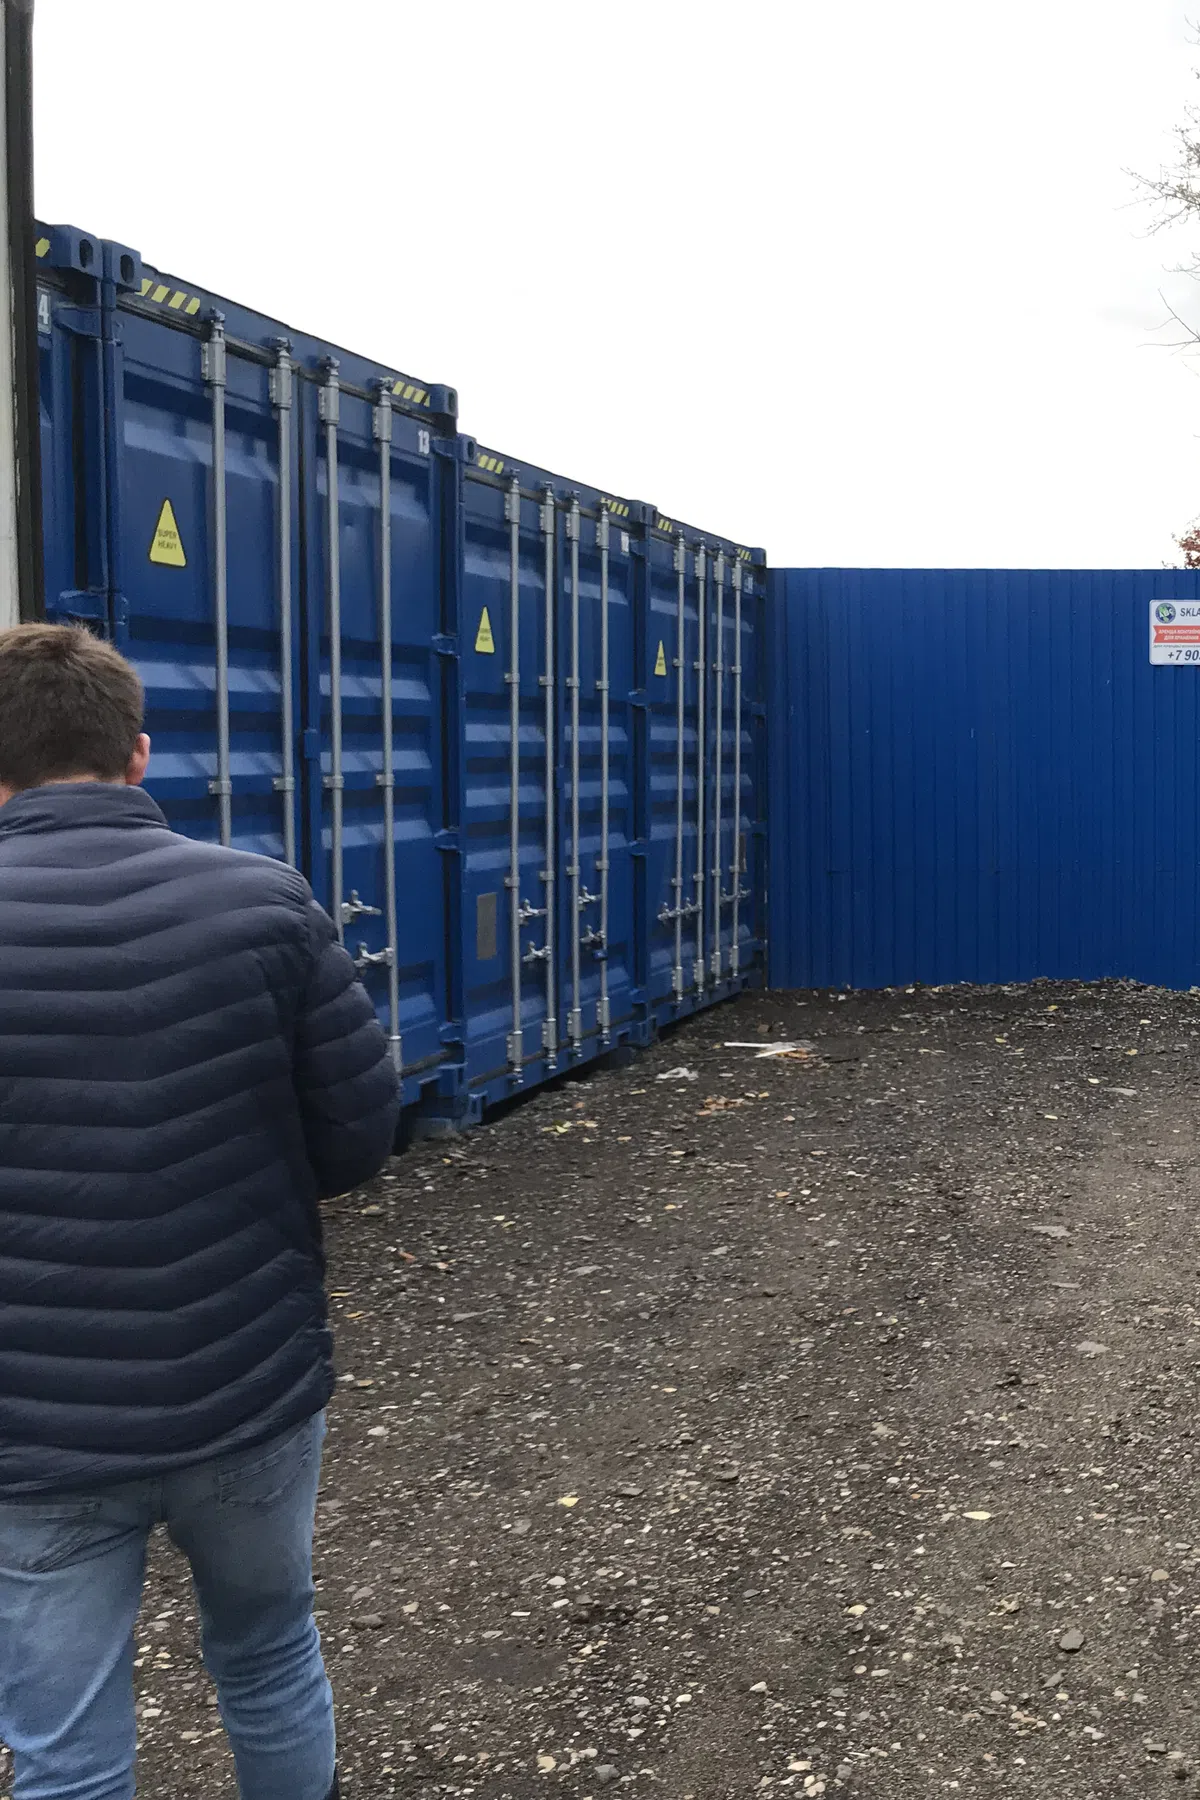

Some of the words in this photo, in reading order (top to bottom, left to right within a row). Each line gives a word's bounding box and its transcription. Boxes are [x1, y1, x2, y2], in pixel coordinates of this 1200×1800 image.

[418, 429, 430, 455] 13
[157, 529, 177, 539] SUPER
[157, 540, 177, 550] HEAVY
[1168, 650, 1182, 661] +7
